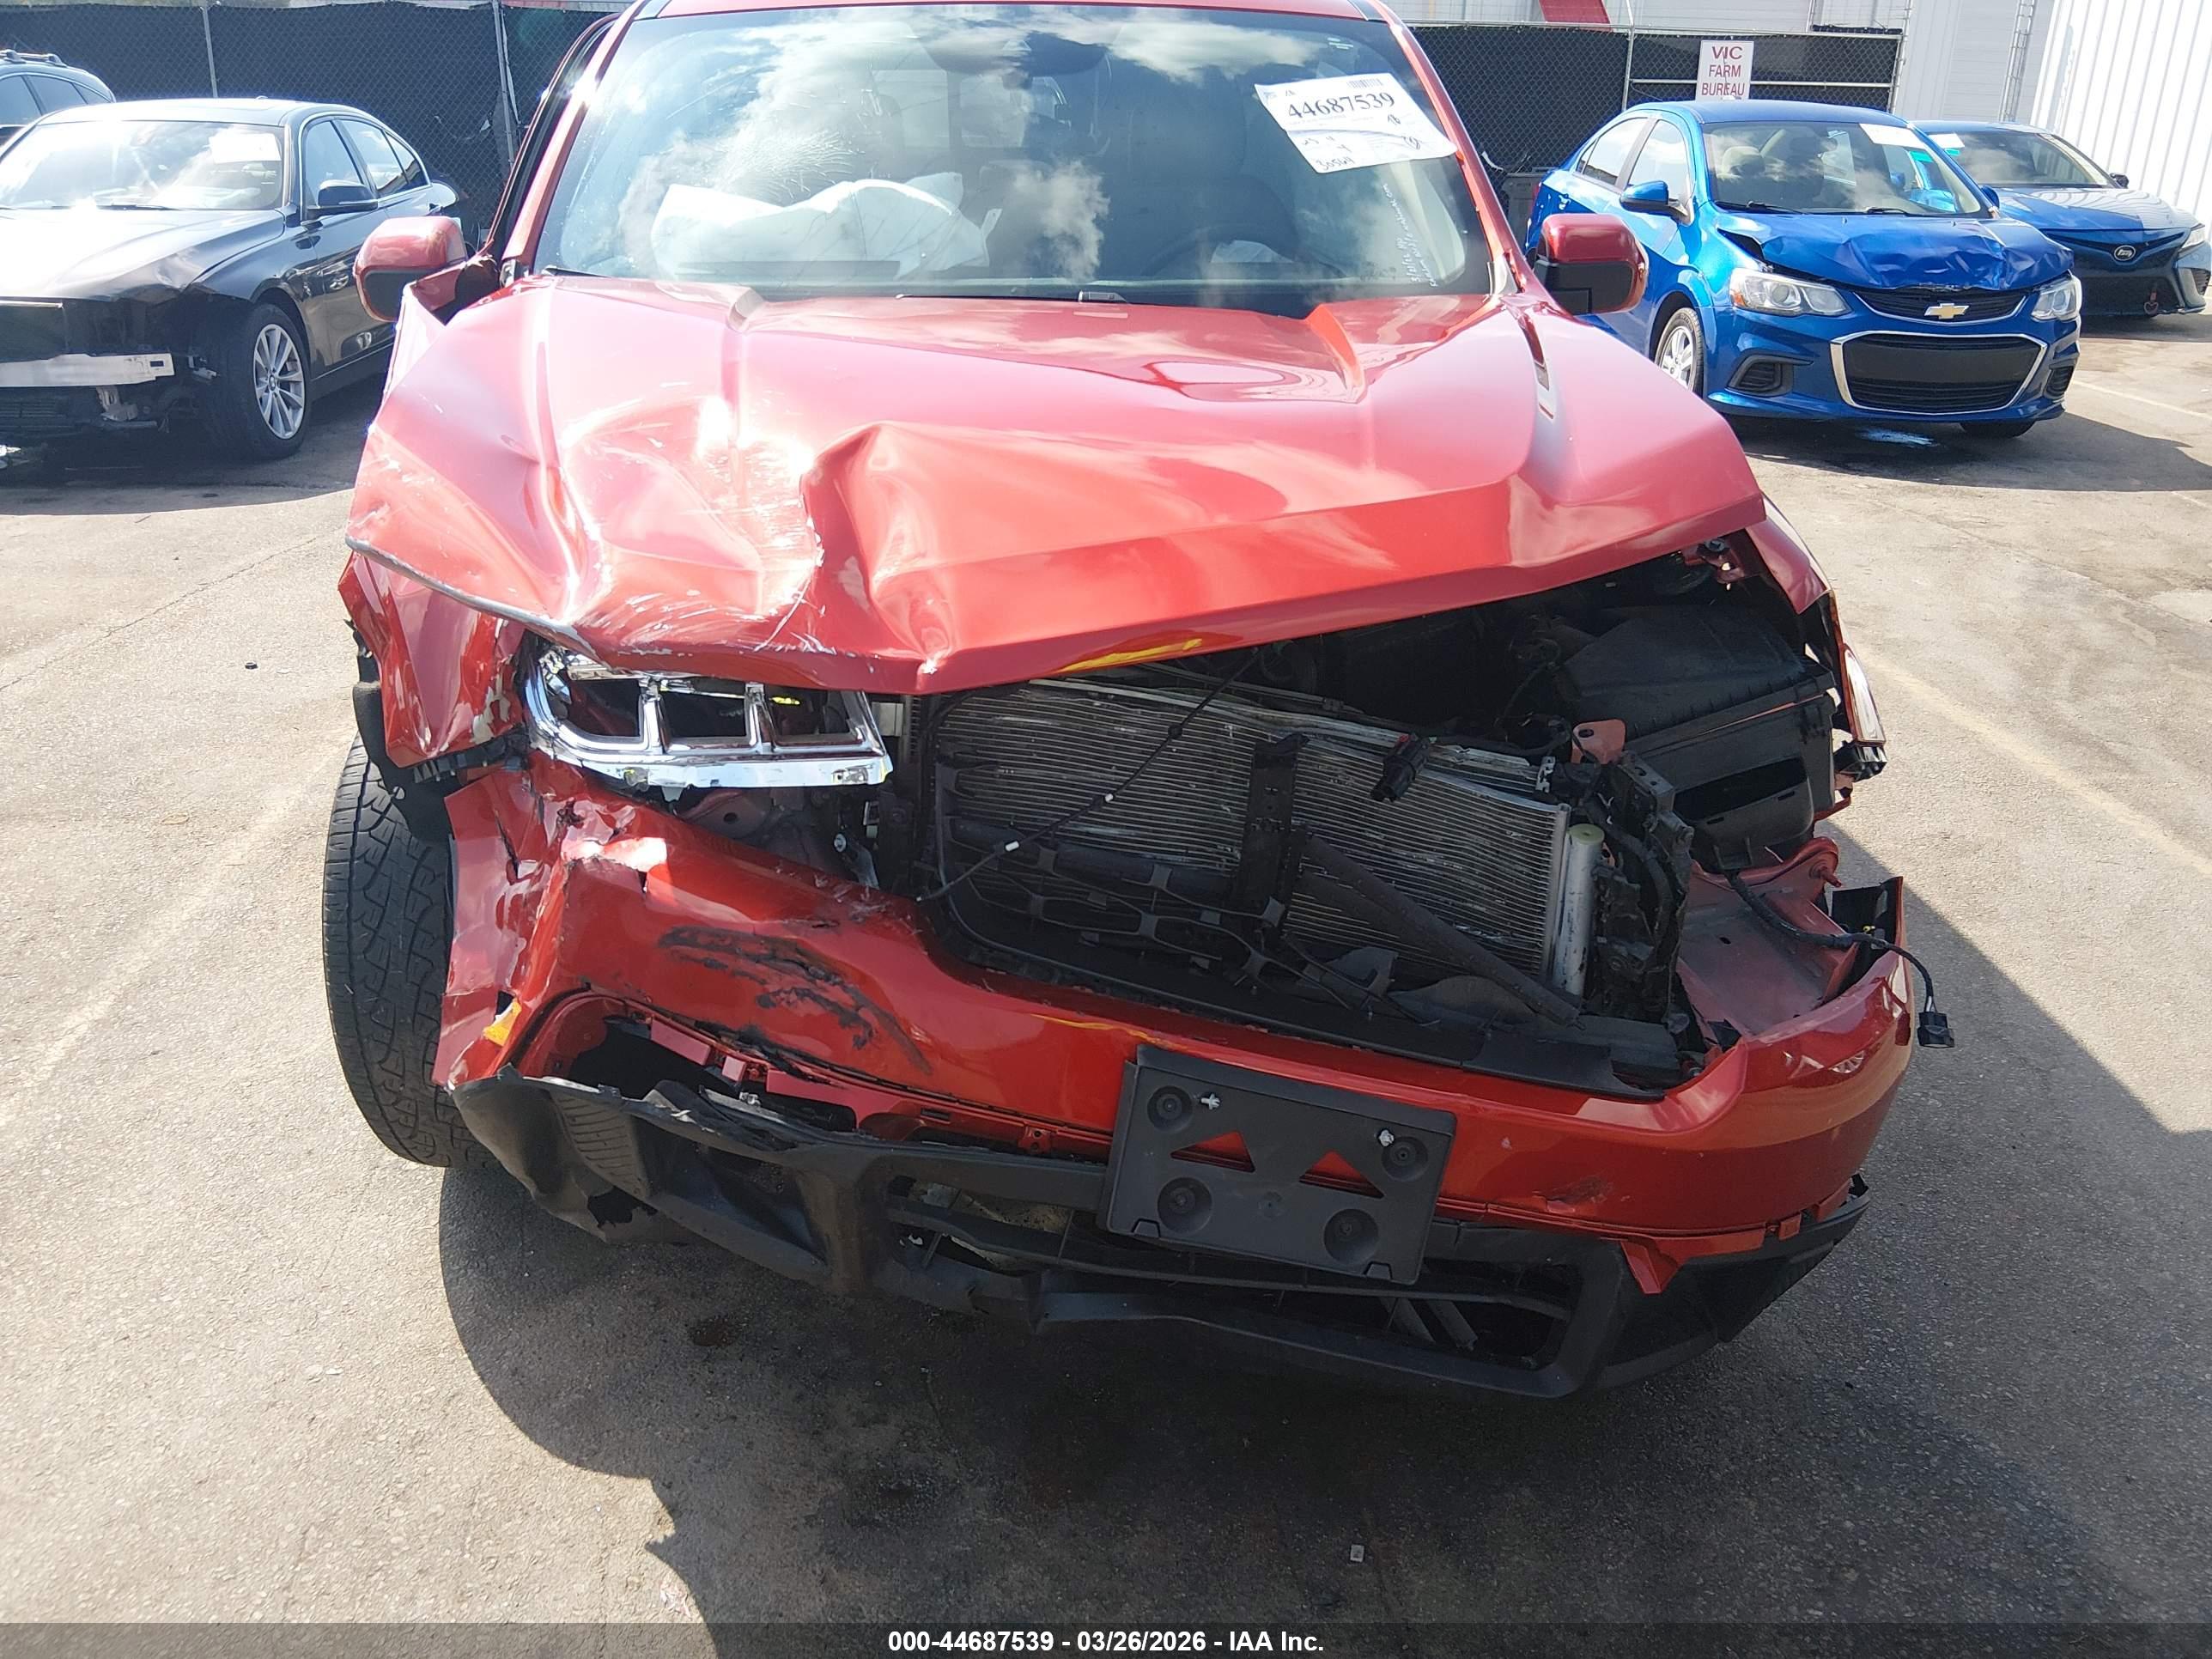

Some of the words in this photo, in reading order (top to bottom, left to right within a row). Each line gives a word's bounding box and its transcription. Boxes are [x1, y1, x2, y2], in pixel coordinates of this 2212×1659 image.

[1711, 46, 1742, 59] VIC
[1709, 64, 1741, 77] FARM
[1701, 82, 1745, 95] BUREAU
[1289, 92, 1395, 118] 44687539
